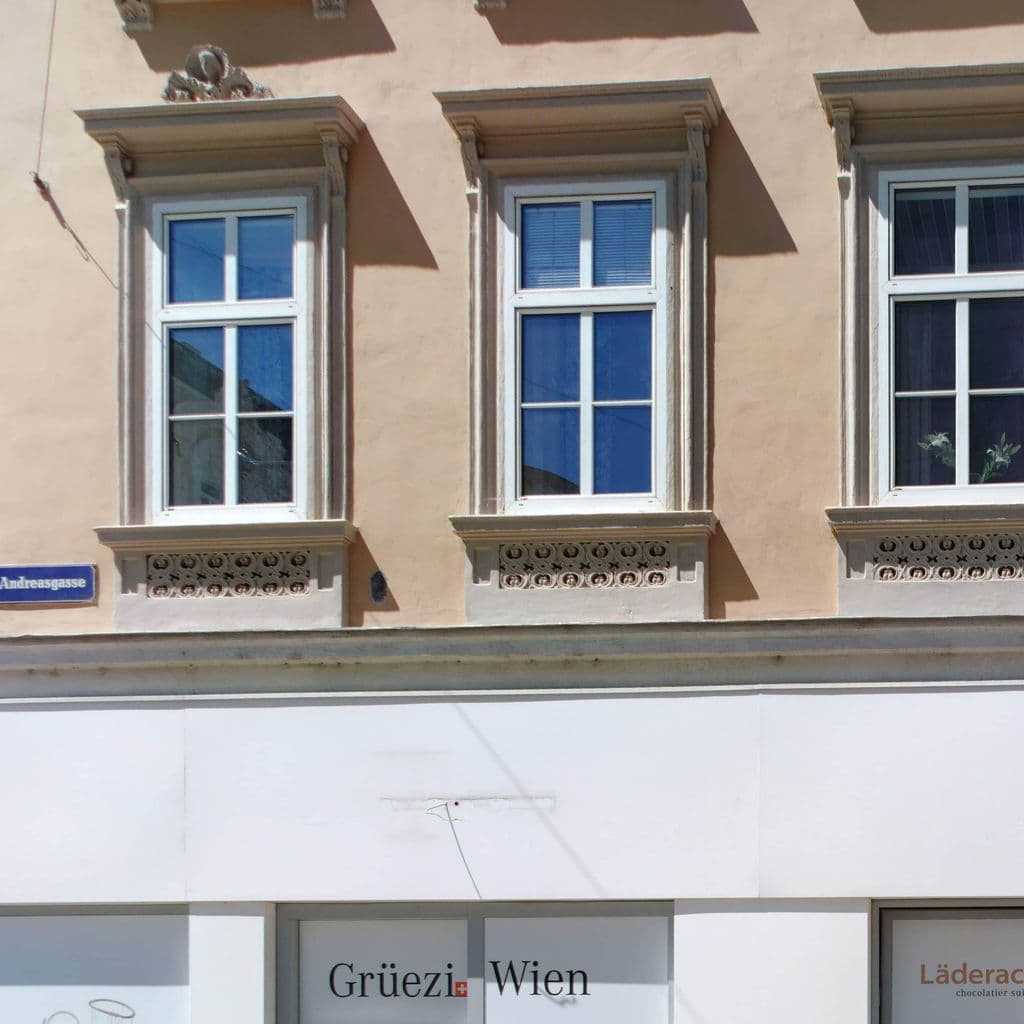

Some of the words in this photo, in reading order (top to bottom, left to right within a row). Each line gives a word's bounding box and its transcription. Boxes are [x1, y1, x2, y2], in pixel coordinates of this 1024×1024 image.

[0, 576, 87, 591] Andreasgasse
[328, 962, 455, 998] Grüezi
[489, 959, 592, 996] Wien
[955, 988, 1008, 998] chocolatier
